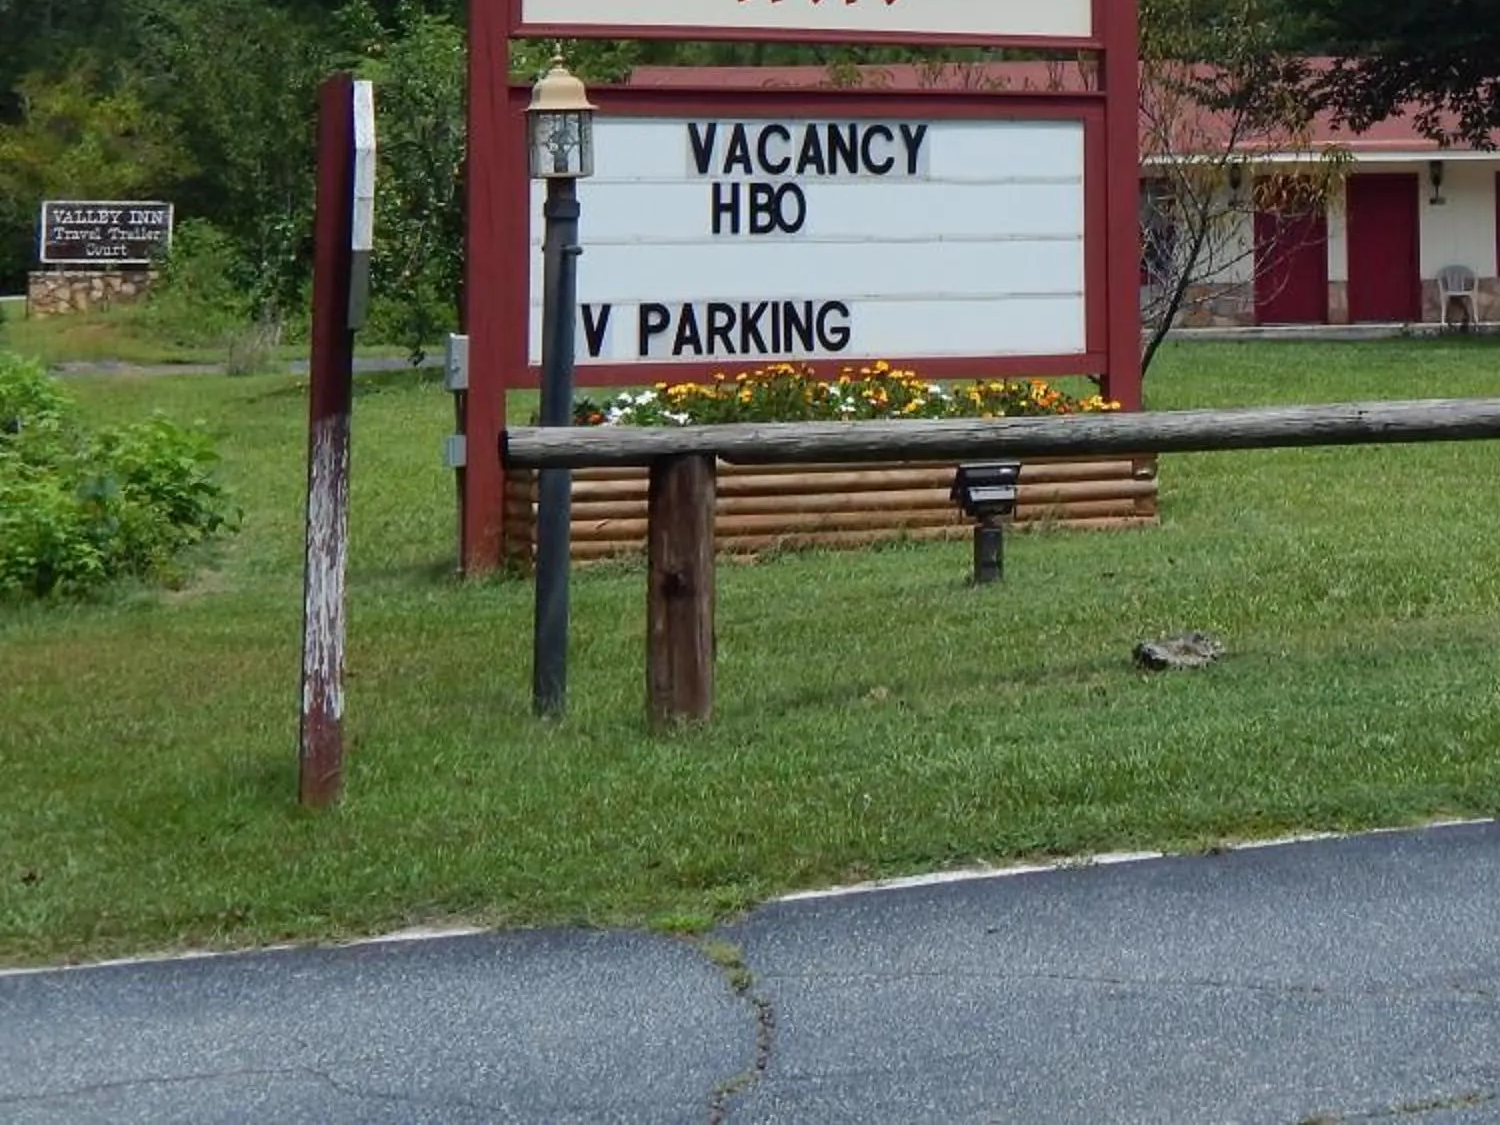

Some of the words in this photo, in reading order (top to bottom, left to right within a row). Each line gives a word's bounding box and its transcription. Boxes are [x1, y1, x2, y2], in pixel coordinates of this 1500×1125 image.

[686, 122, 929, 176] VACANCY
[53, 210, 122, 224] VALLEY
[128, 210, 164, 224] INN
[711, 181, 807, 235] HBO
[54, 226, 101, 240] Travel
[107, 226, 160, 240] Trailer
[86, 242, 128, 256] Court
[638, 300, 851, 357] PARKING
